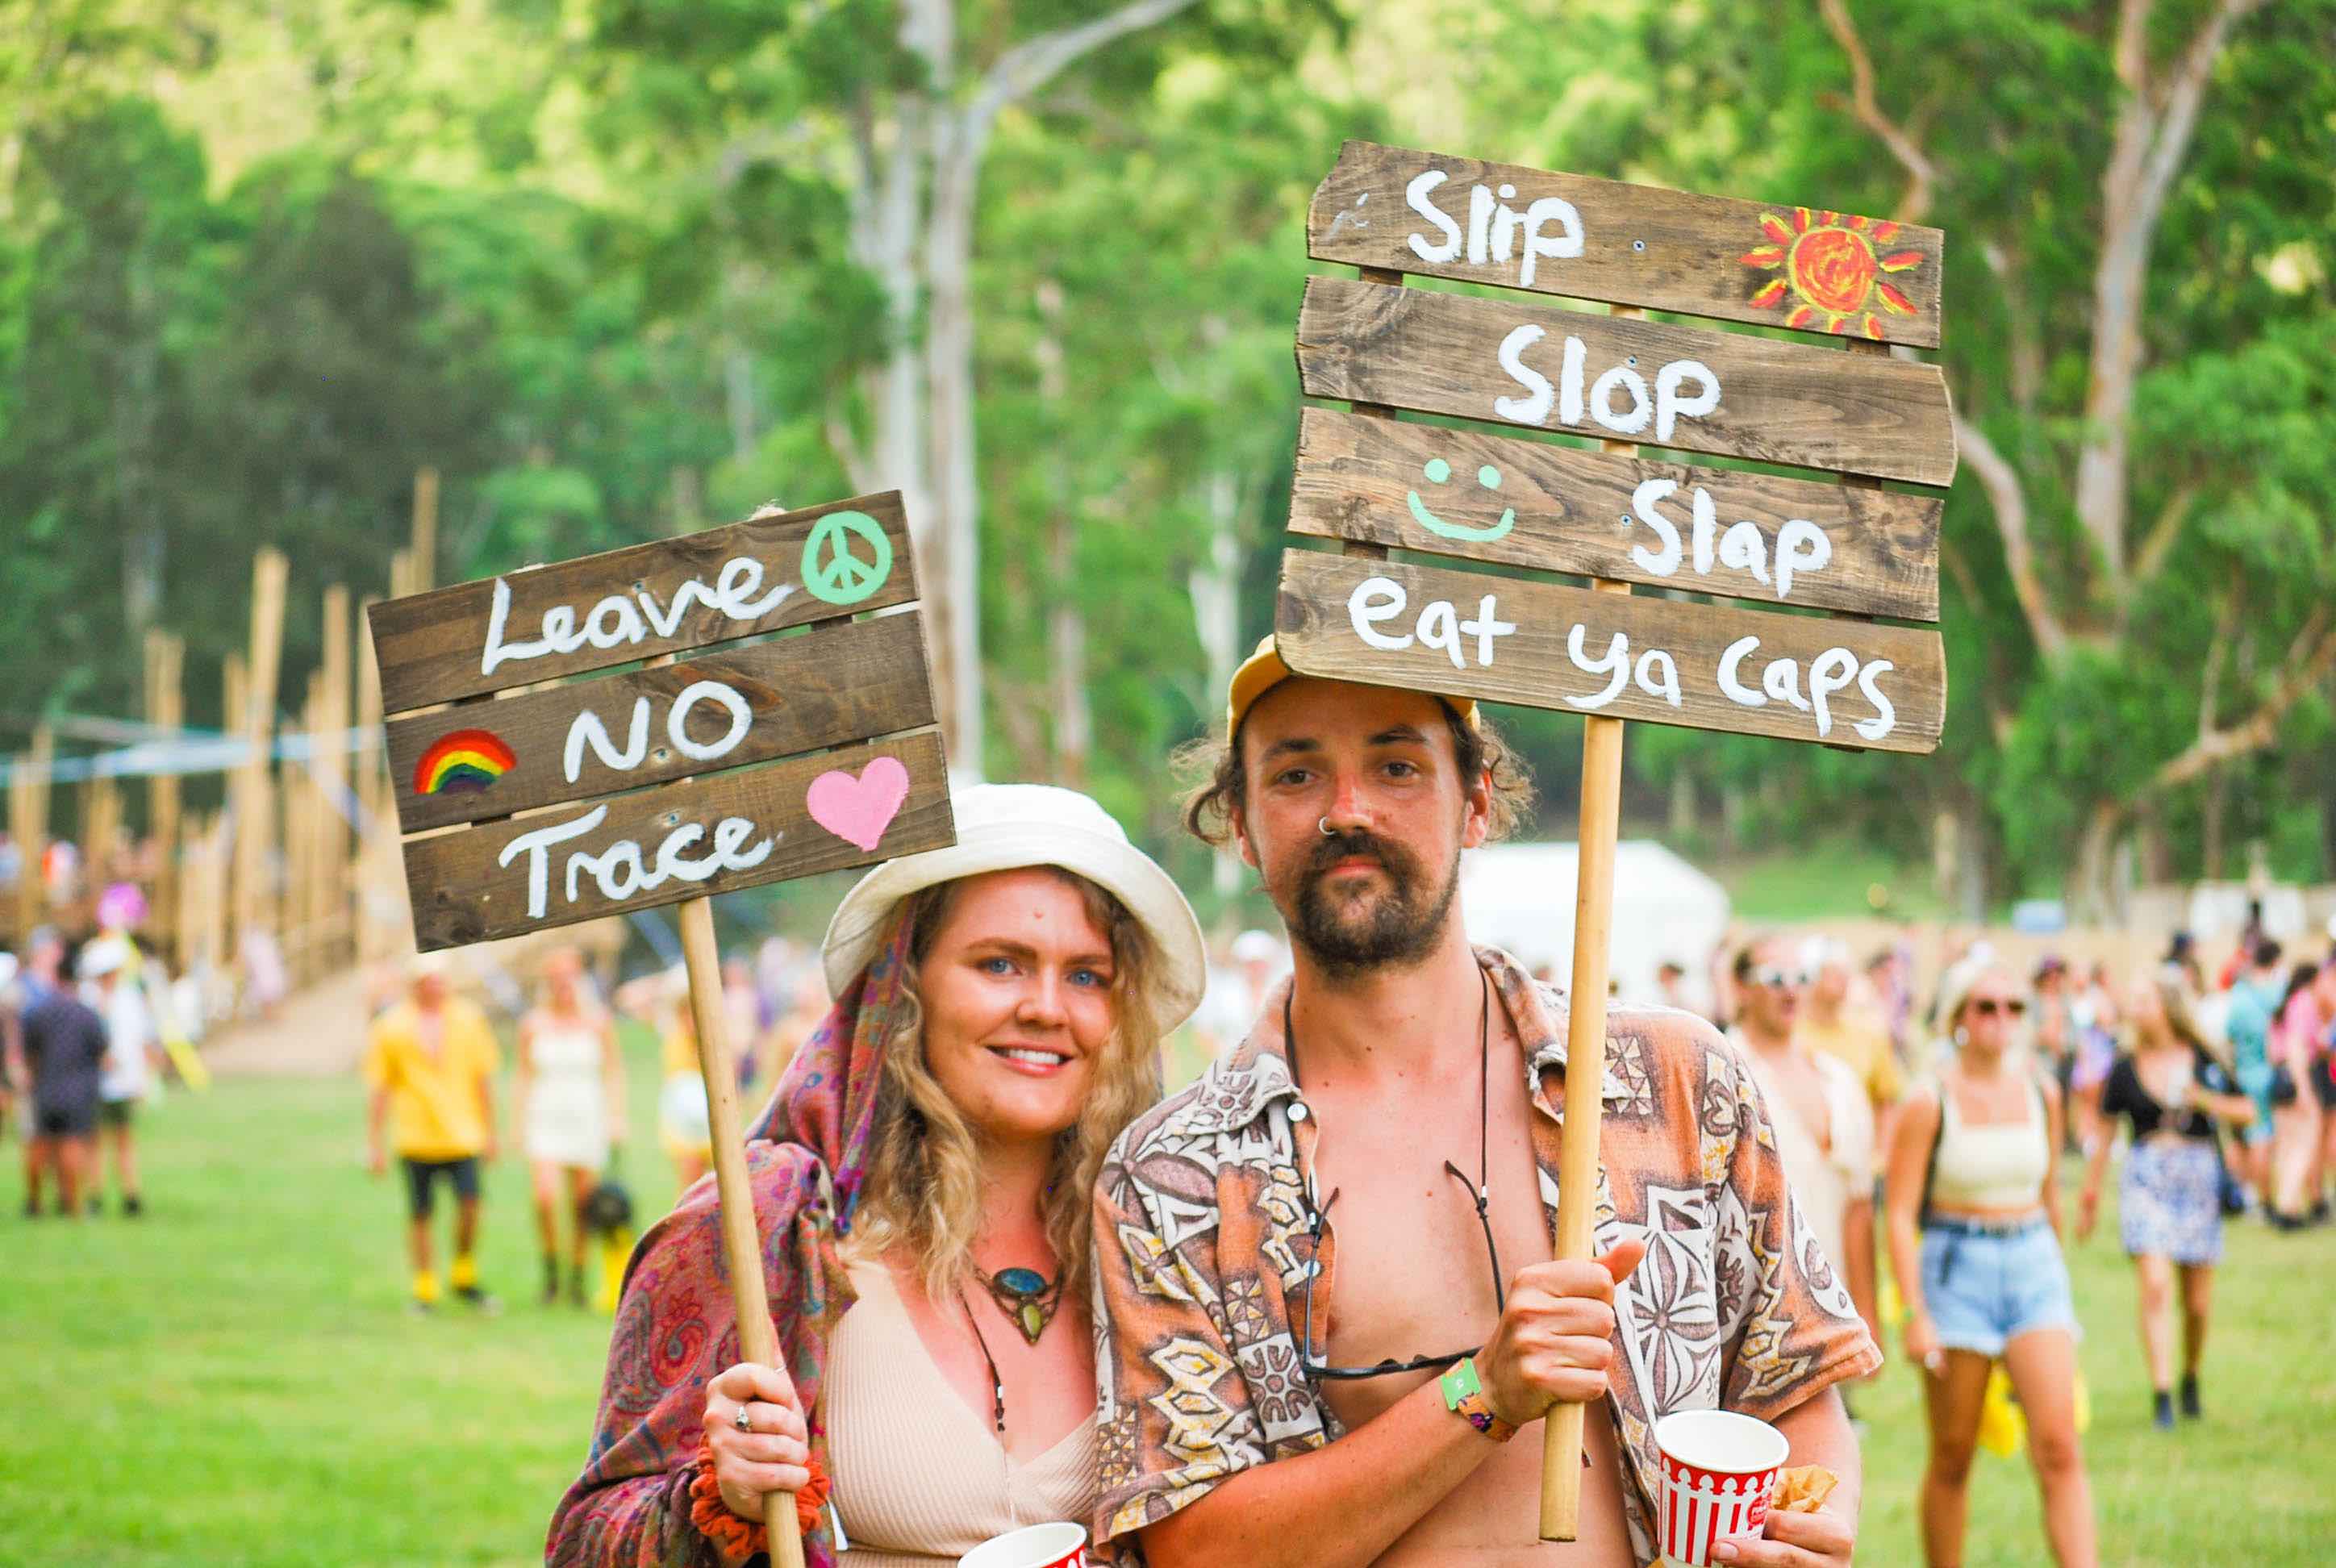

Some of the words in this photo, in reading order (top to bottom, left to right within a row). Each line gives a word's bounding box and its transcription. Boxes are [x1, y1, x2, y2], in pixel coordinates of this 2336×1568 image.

[1406, 170, 1586, 286] Slip
[1494, 324, 1721, 441] Slop
[1630, 478, 1832, 598] Slap
[482, 557, 795, 675] Leave
[1348, 577, 1516, 669] eat
[1564, 623, 1682, 708] ya
[498, 803, 774, 918] Trace
